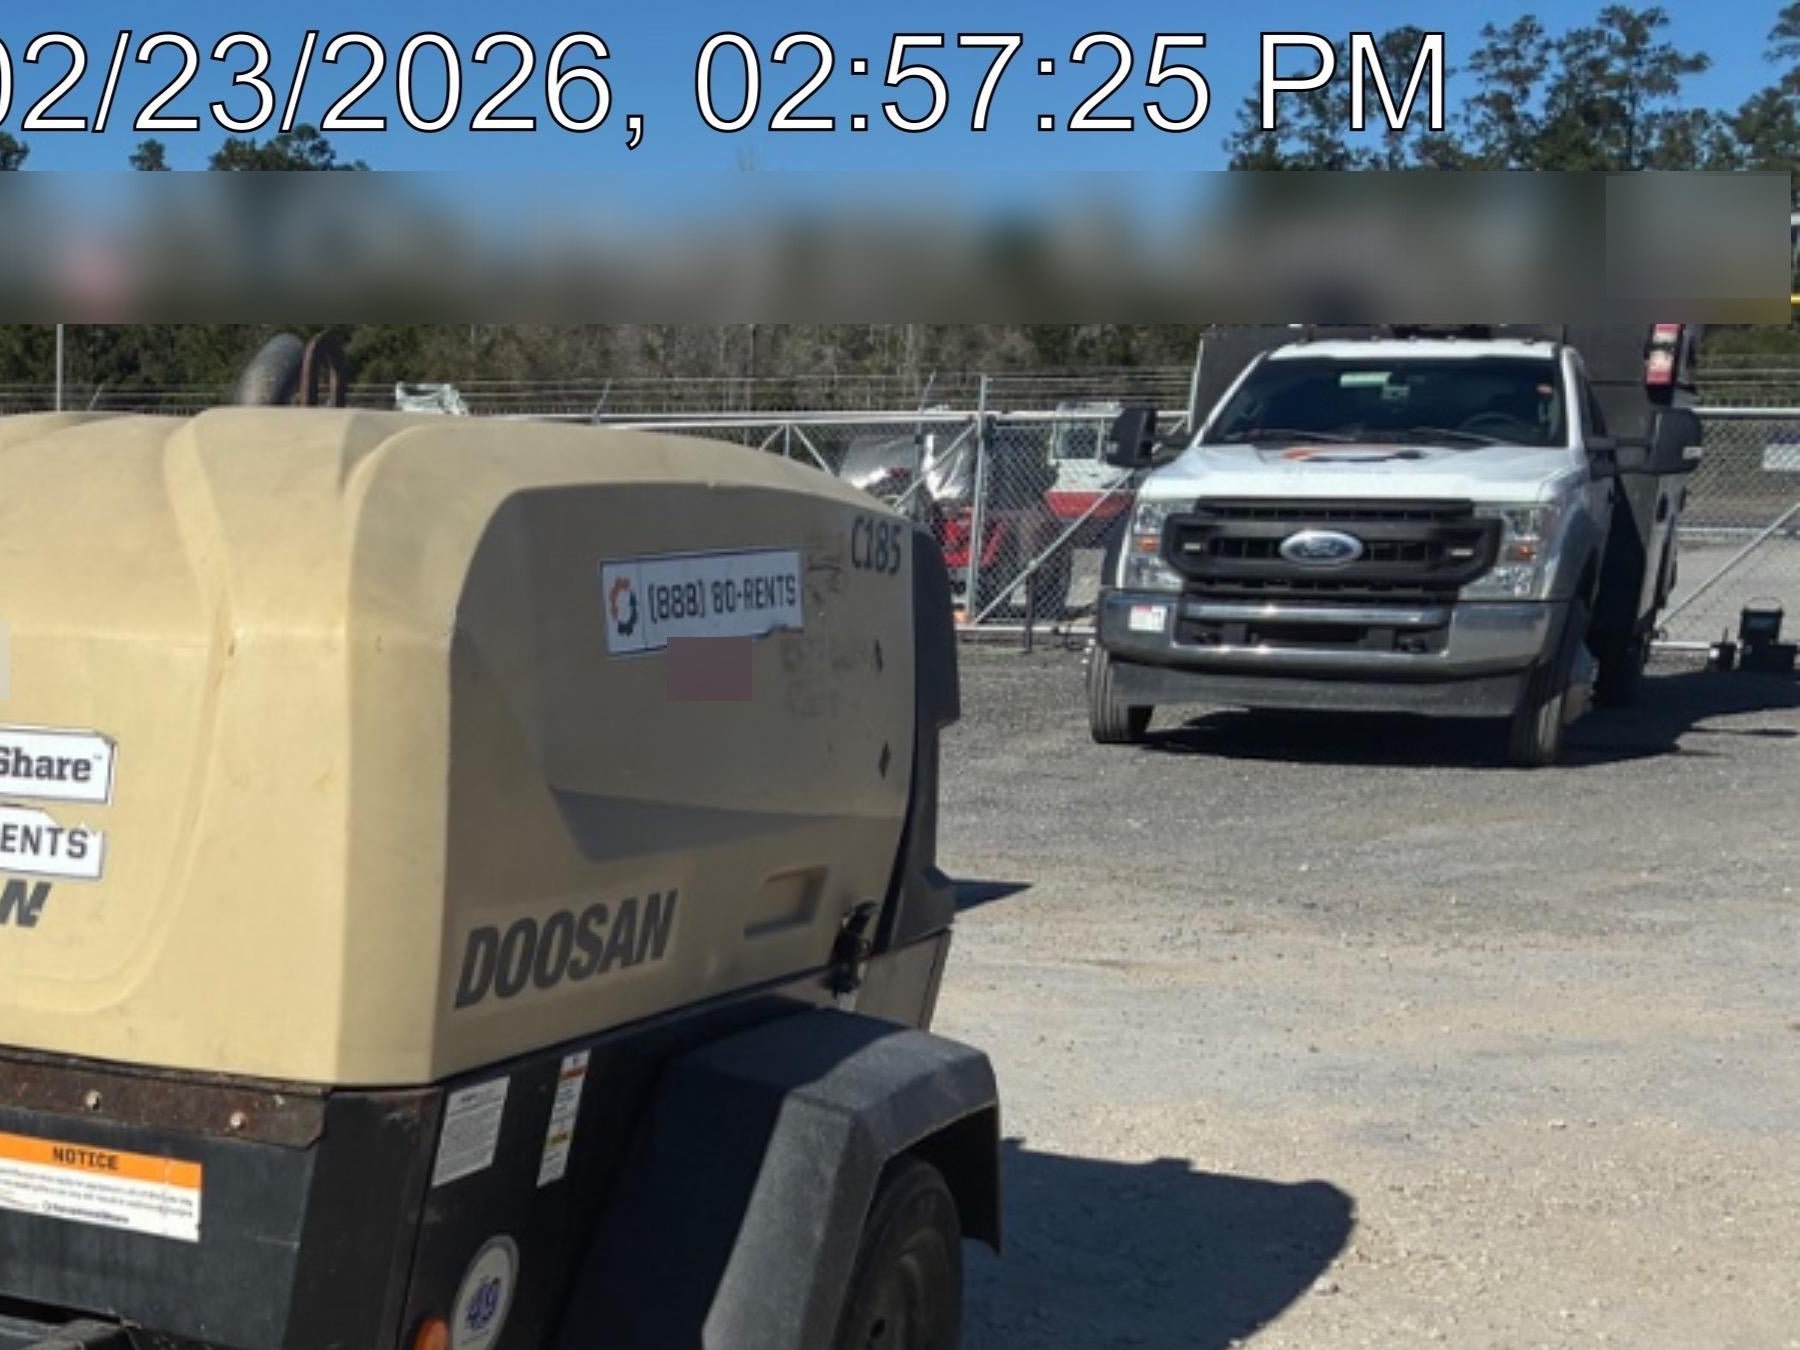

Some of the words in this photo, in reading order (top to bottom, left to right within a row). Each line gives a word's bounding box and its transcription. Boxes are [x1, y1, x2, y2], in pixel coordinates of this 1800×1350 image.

[851, 518, 902, 576] C185
[647, 581, 706, 624] (888)
[711, 574, 798, 614] 80-RENTS
[455, 890, 679, 1010] DOOSAN
[52, 1145, 120, 1170] NOTICE
